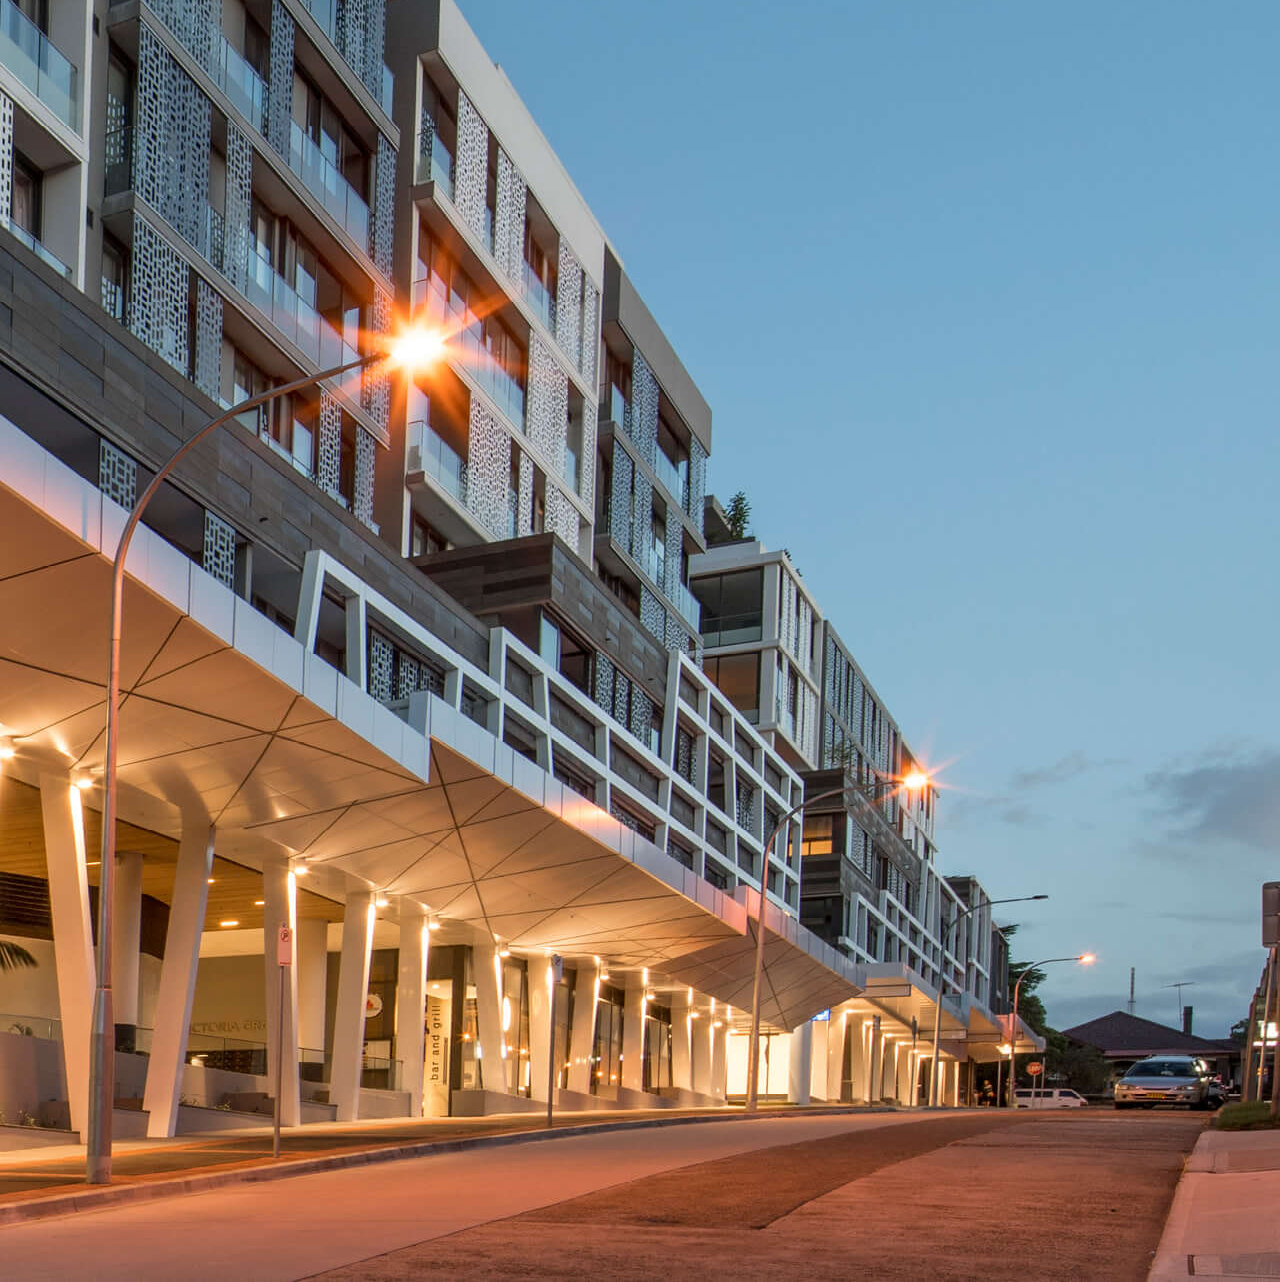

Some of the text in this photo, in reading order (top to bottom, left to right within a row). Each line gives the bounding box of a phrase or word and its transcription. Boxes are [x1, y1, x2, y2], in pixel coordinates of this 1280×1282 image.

[430, 1005, 442, 1082] bar and grill
